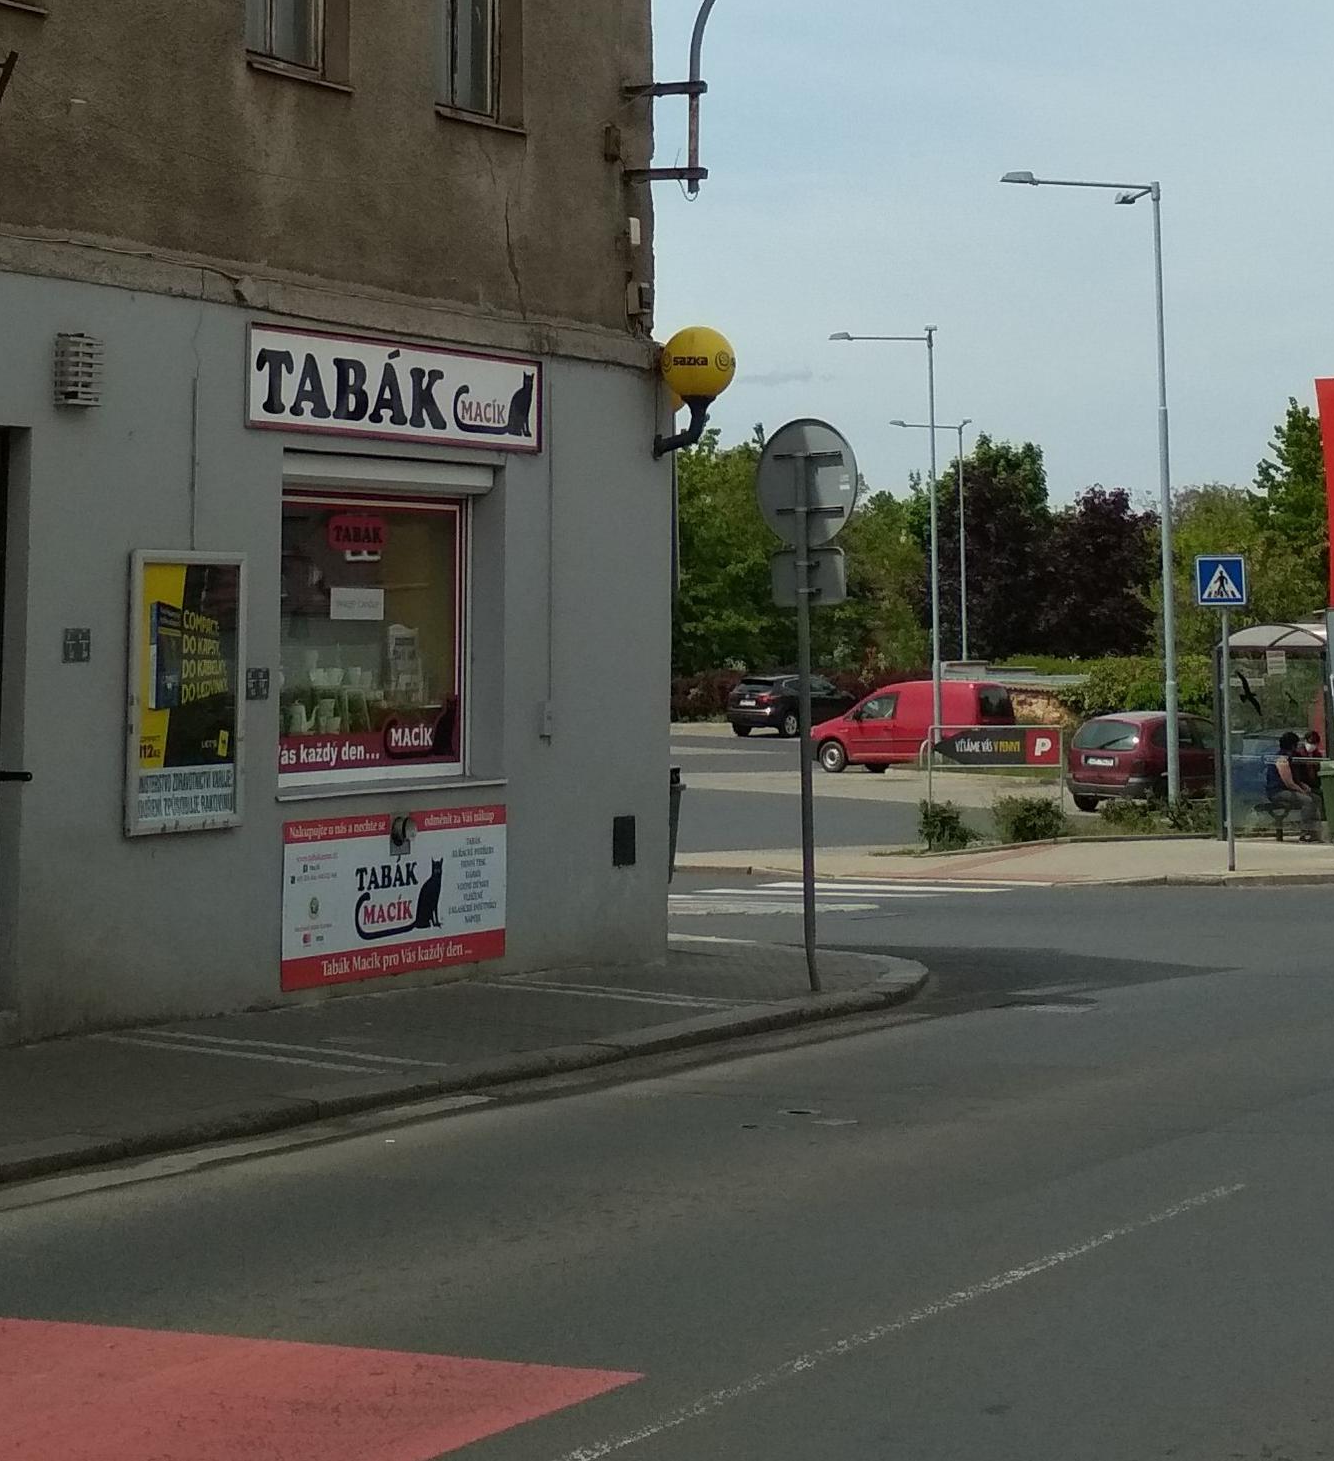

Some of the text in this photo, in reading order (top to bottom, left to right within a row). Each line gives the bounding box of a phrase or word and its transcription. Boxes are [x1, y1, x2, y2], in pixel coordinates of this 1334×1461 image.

[256, 348, 447, 430] TABÁK
[460, 399, 506, 424] MACÍK
[333, 523, 384, 544] TABÁK
[182, 634, 196, 654] DO
[182, 659, 196, 679] DO
[181, 683, 195, 704] DO
[391, 723, 433, 747] MACÍK
[955, 737, 981, 753] VÍTÁME
[1034, 738, 1052, 756] P
[279, 746, 296, 765] ás
[300, 741, 338, 767] každý
[355, 855, 419, 891] TABÁK
[362, 894, 413, 926] MACÍK
[322, 958, 350, 977] Tabák
[352, 951, 380, 971] Macík
[383, 953, 399, 971] pro
[401, 946, 416, 964] Vás
[418, 942, 445, 963] každý
